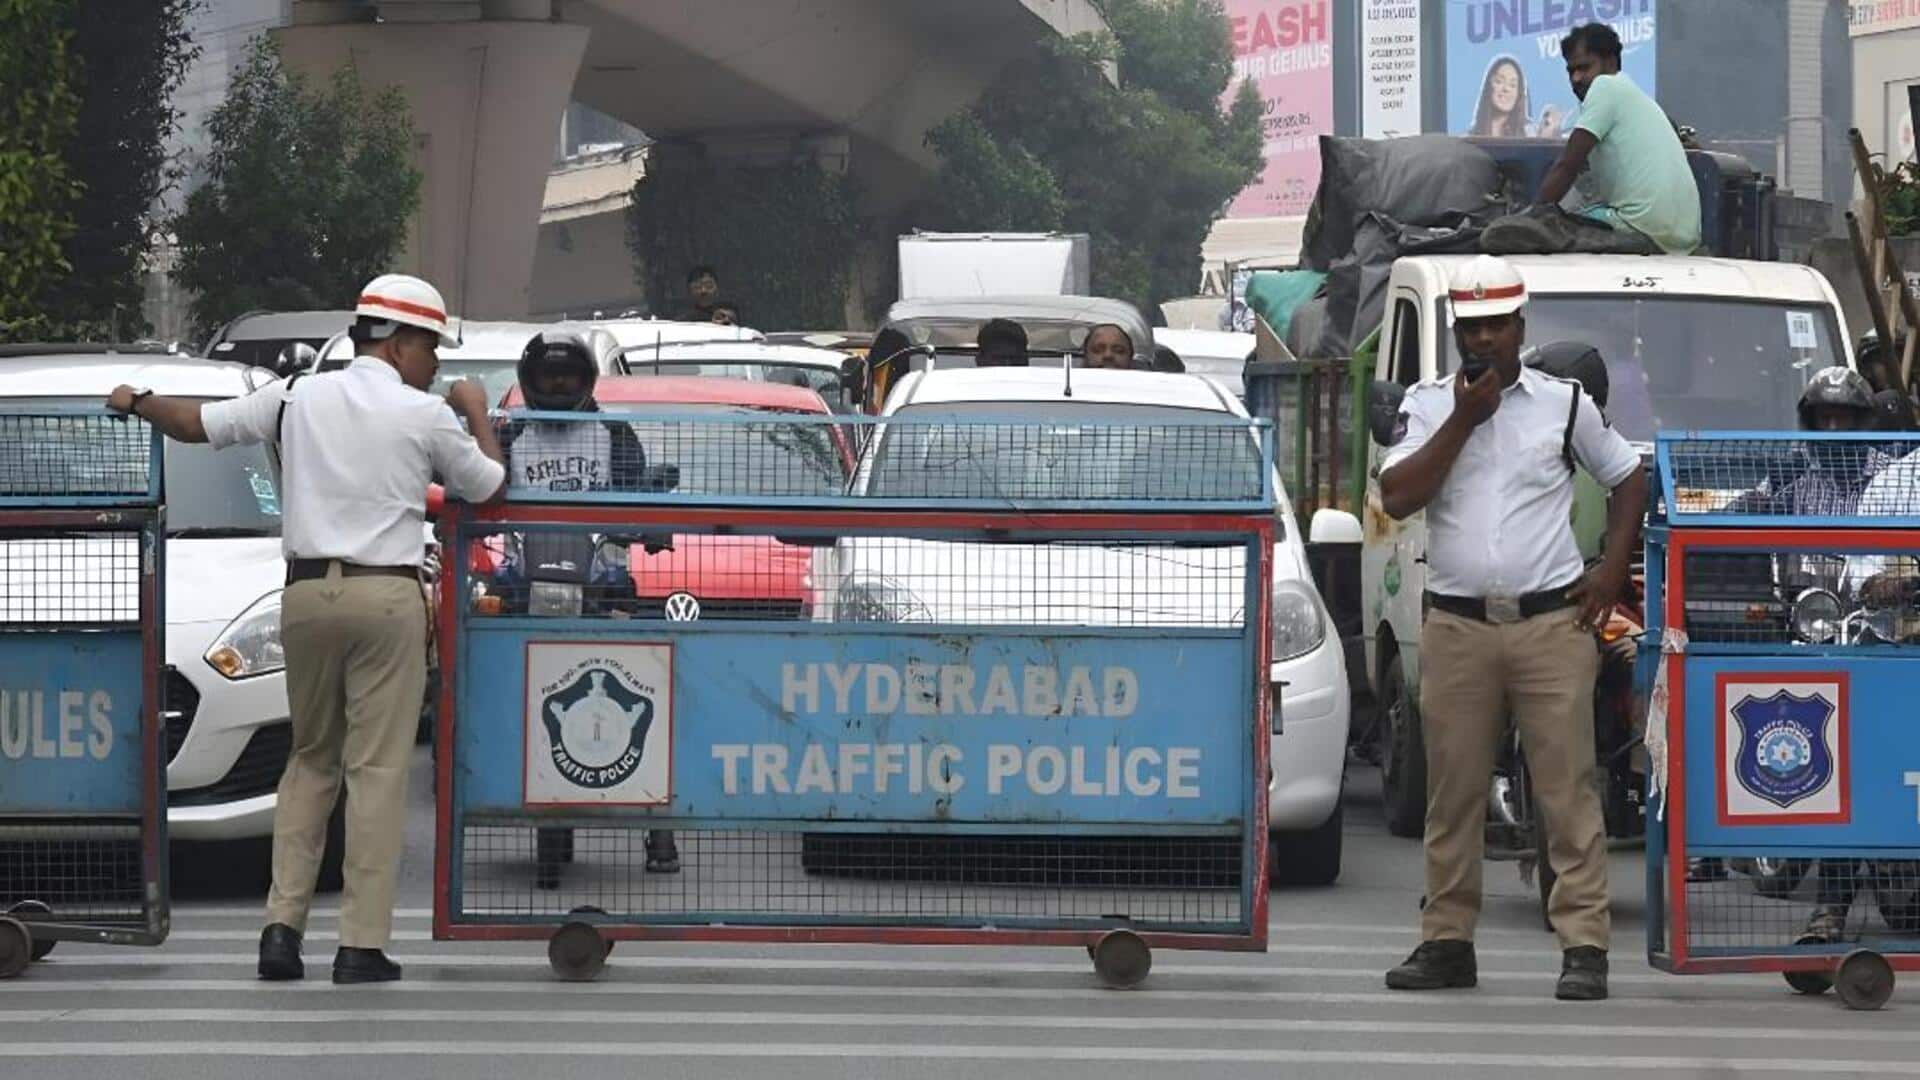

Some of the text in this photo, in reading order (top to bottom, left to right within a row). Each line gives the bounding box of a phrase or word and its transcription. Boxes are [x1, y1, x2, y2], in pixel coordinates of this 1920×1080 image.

[1270, 44, 1330, 75] GENIUS
[781, 662, 1138, 718] HYDERABAD
[0, 690, 113, 760] ULES
[552, 741, 641, 784] TRAFFIC POLICE
[712, 743, 1200, 798] TRAFFIC POLICE
